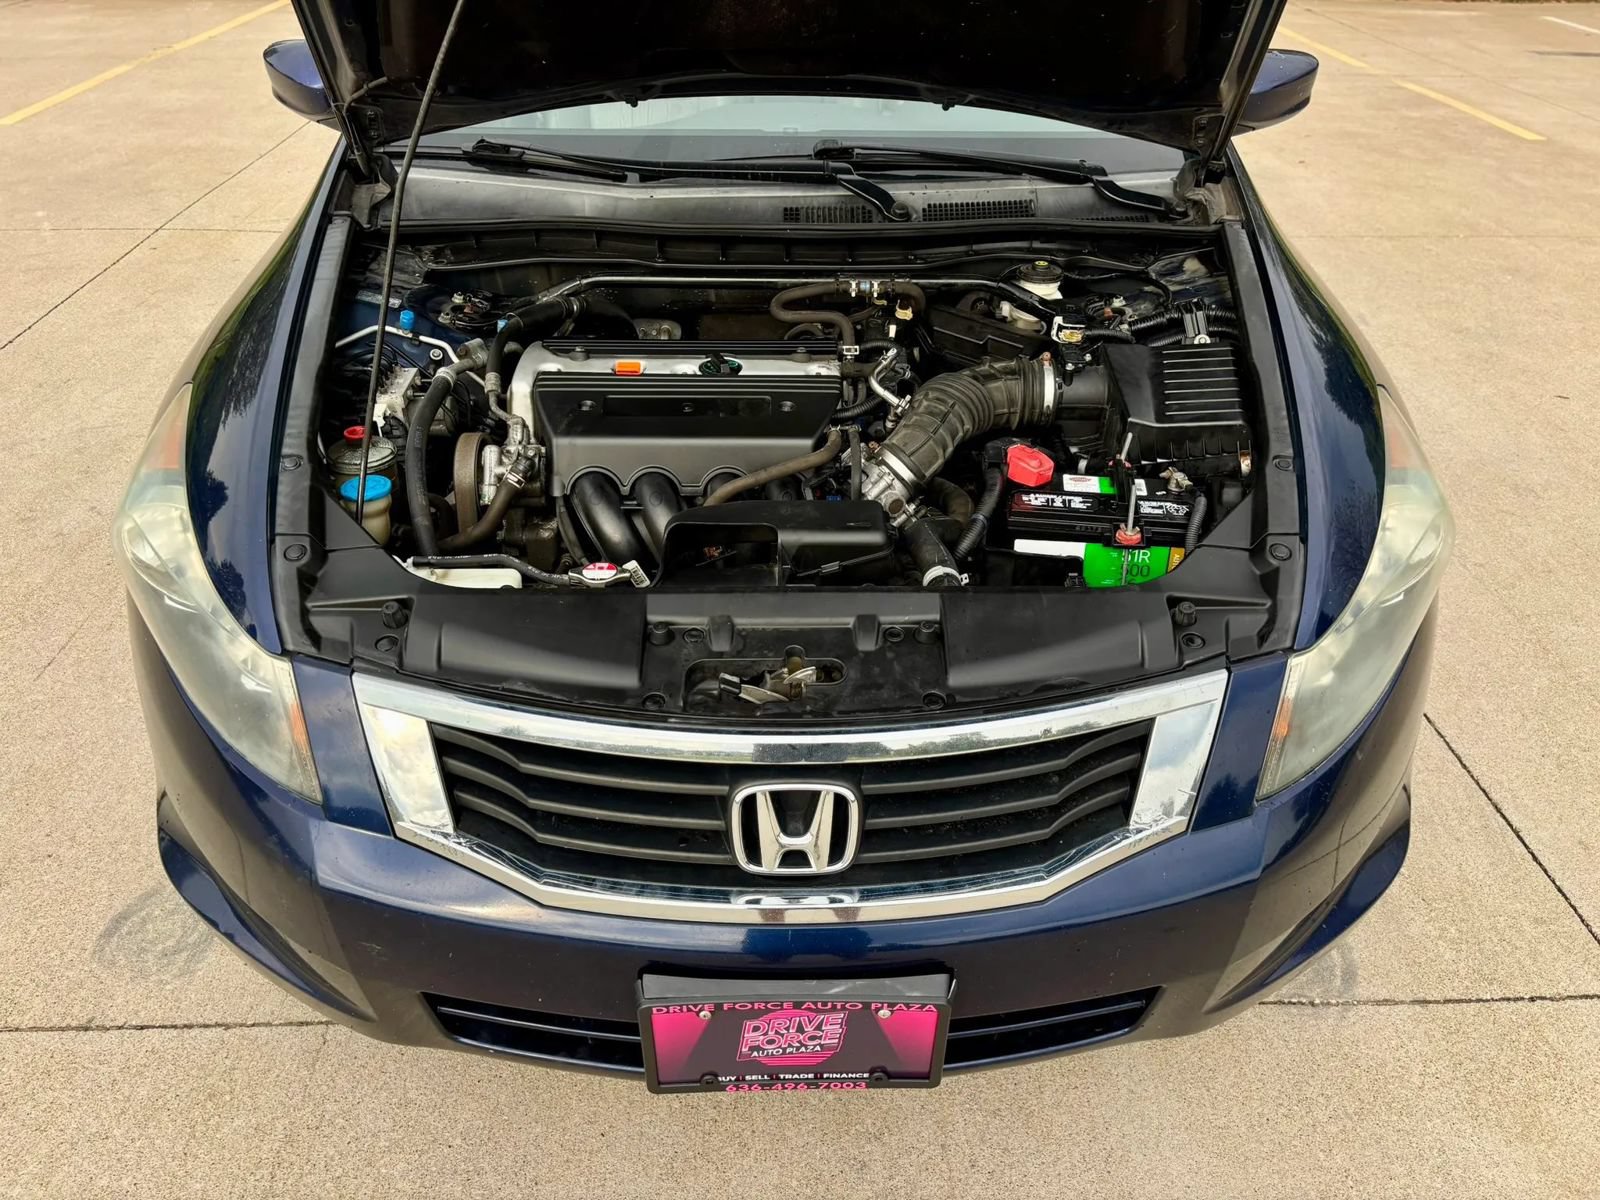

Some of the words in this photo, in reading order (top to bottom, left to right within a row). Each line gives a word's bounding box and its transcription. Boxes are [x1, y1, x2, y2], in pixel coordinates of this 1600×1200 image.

[652, 1004, 715, 1014] DRIVE
[723, 1002, 794, 1010] FORCE
[801, 1002, 863, 1010] AUTO
[871, 1003, 937, 1012] PLAZA
[744, 1013, 844, 1037] DRIVE
[741, 1028, 843, 1052] FORCE
[751, 1048, 783, 1058] AUTO
[786, 1044, 821, 1055] PLAZA
[725, 1082, 867, 1093] 636-496-7003
